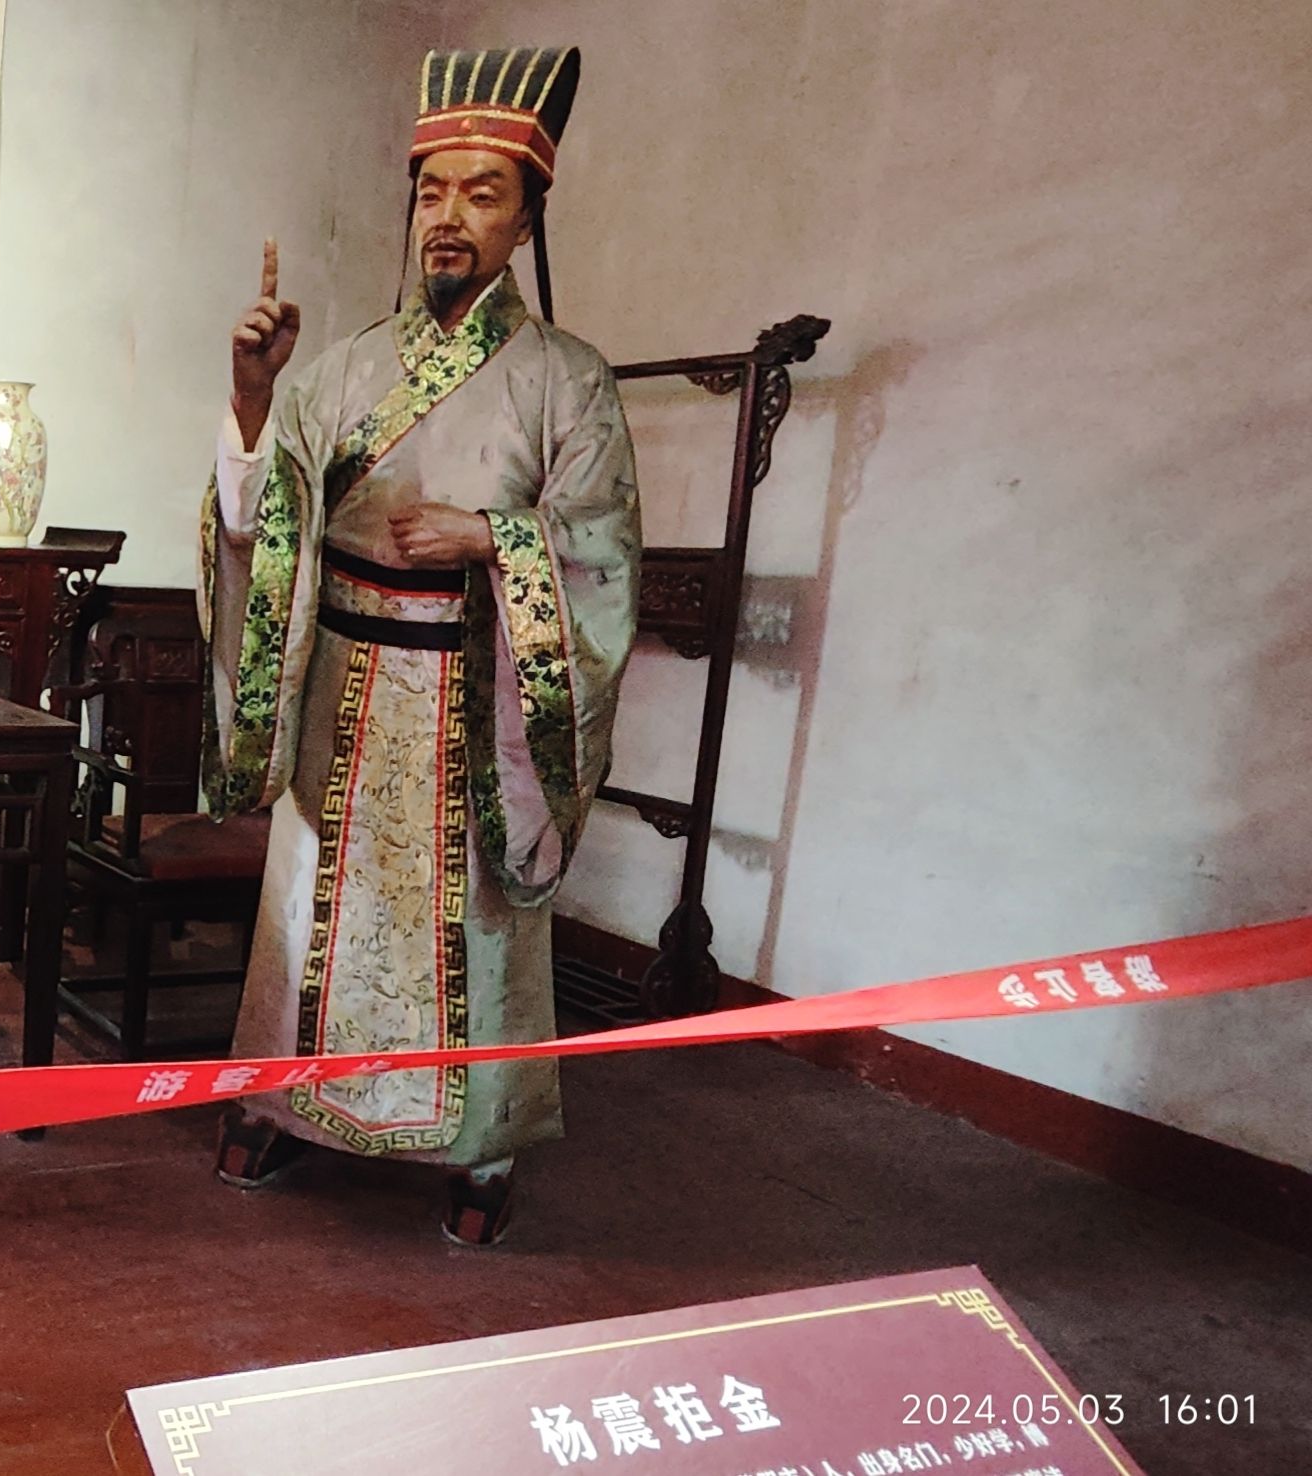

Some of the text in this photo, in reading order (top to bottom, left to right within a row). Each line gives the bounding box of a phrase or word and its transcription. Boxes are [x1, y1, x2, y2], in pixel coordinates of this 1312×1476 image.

[998, 954, 1169, 1009] 游客止步
[530, 1374, 781, 1466] 杨震拒金
